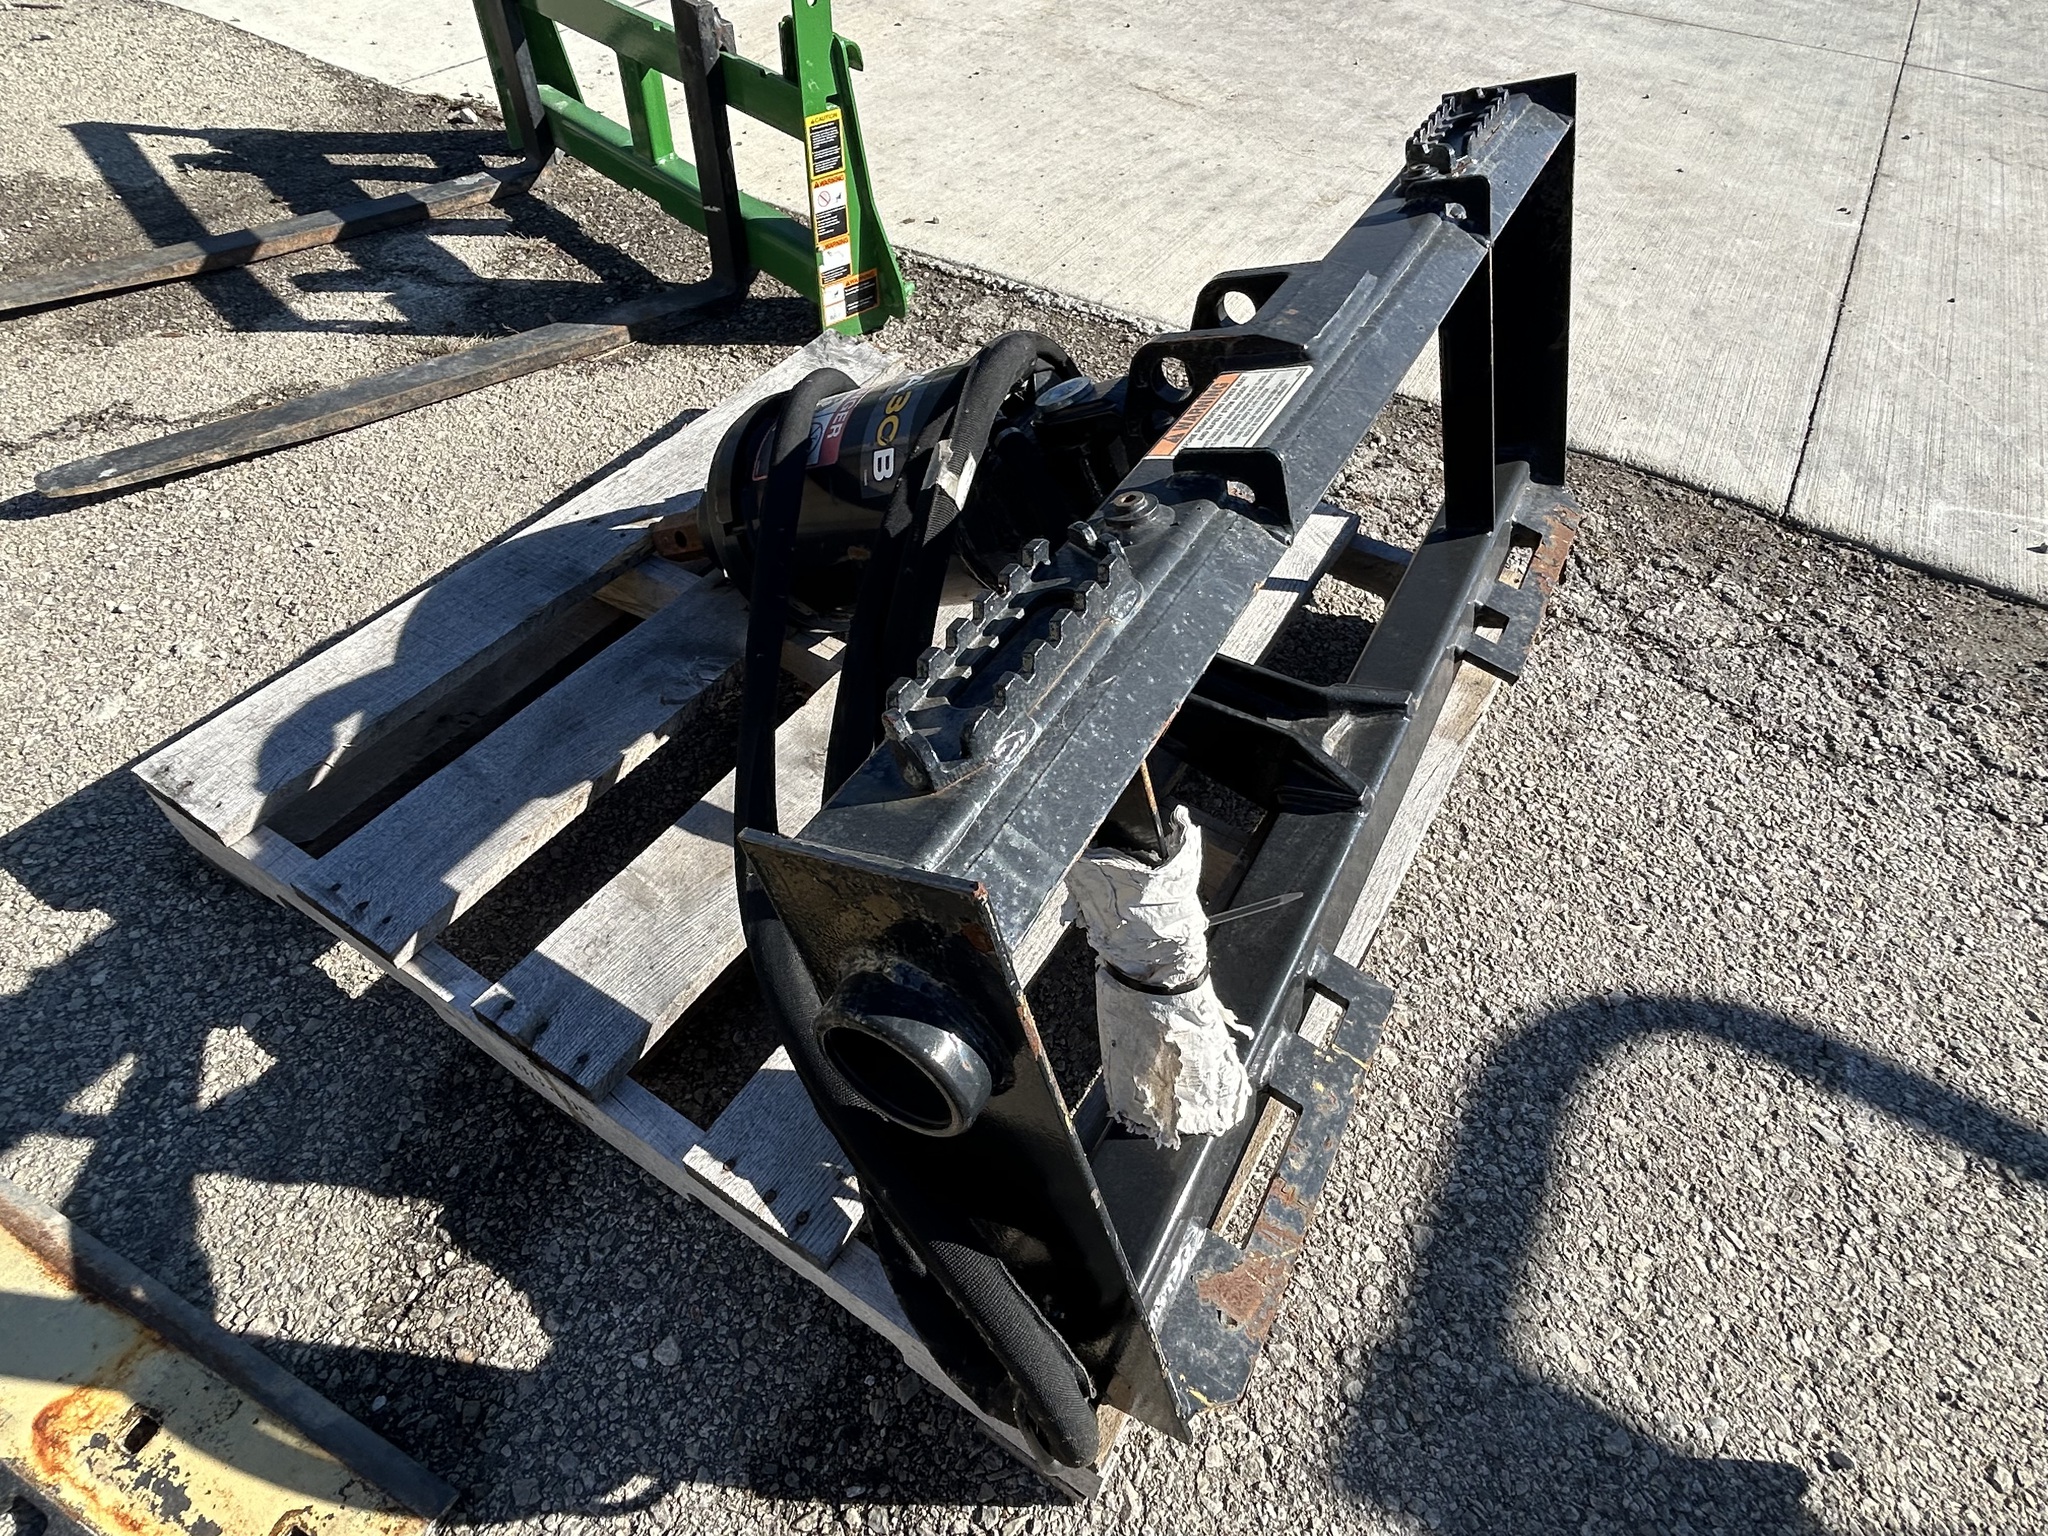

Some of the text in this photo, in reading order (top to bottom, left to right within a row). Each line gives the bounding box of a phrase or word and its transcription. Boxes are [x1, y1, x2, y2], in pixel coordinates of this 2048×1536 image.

[814, 112, 838, 123] CAUTION
[819, 174, 845, 187] WARNING
[1176, 382, 1230, 431] WARNING
